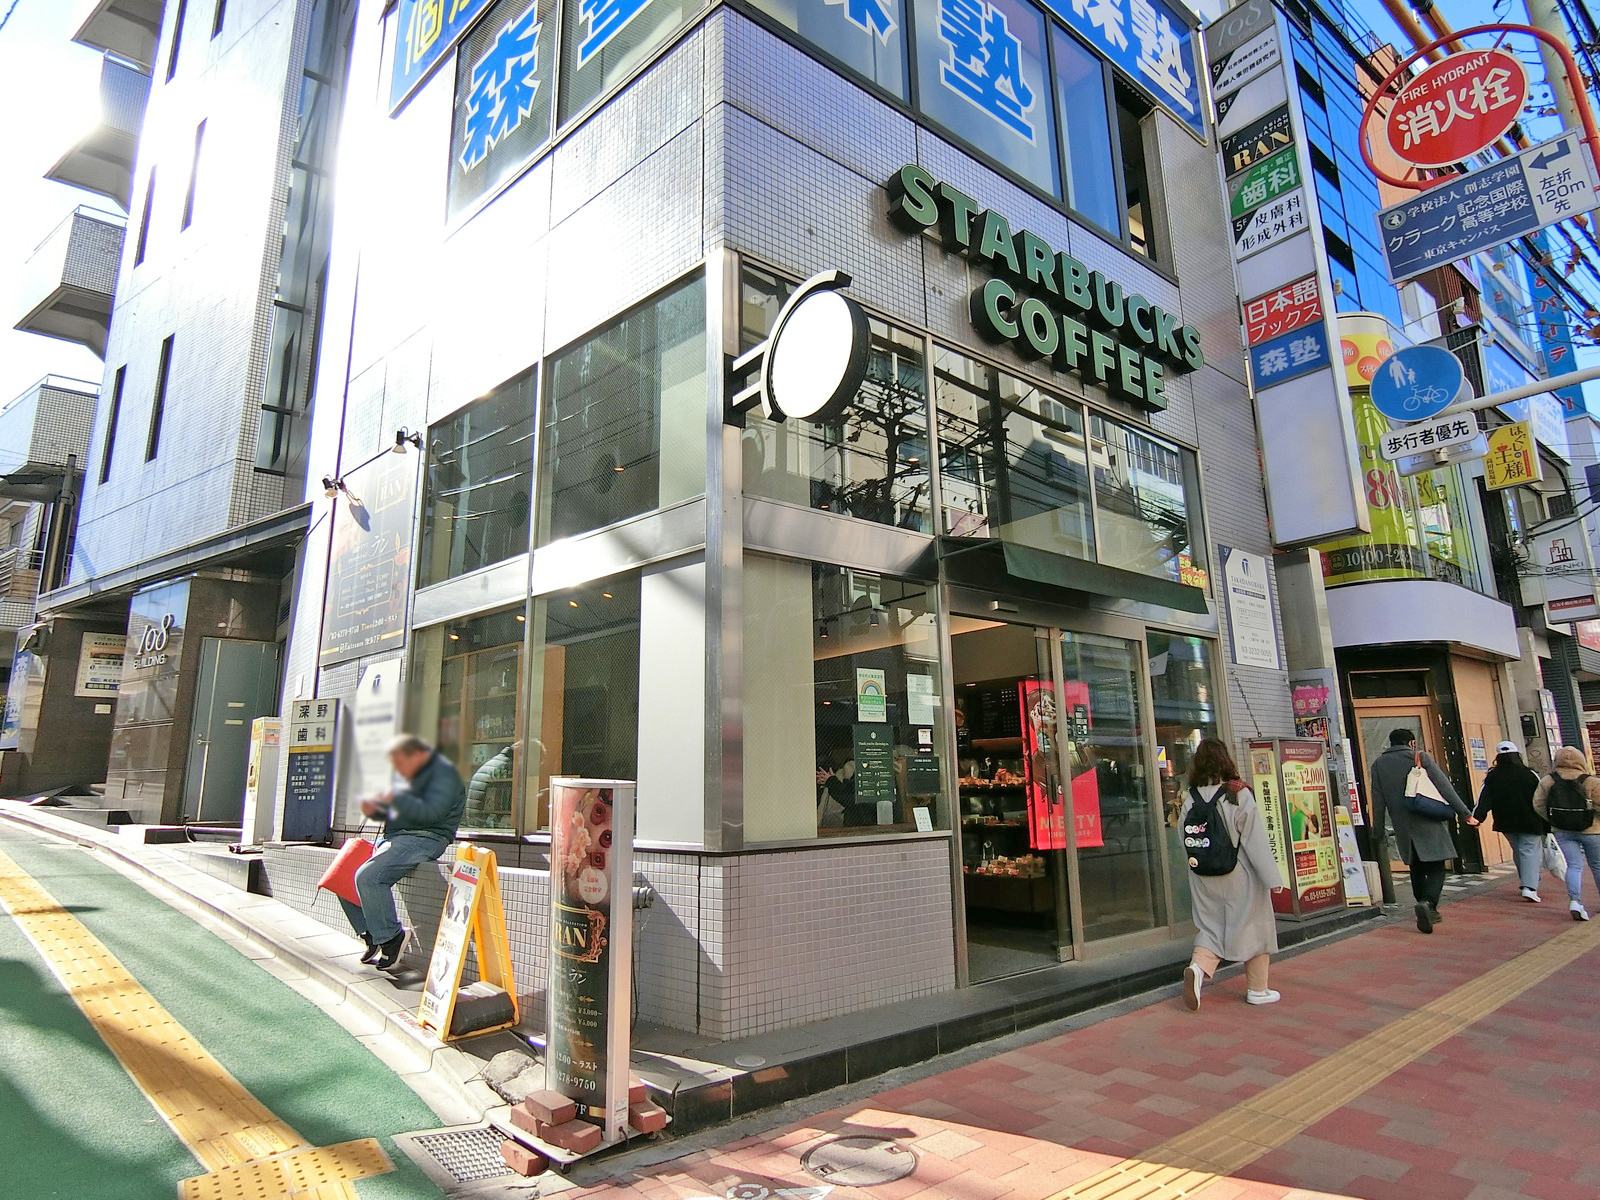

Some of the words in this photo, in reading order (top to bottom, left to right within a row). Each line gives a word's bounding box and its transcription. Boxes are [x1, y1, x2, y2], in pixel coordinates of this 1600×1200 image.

[1213, 60, 1226, 76] 9F
[1401, 83, 1429, 104] FIRE
[1432, 52, 1490, 89] HYDRANT
[459, 1, 543, 174] 森
[1219, 97, 1233, 113] 8F
[1262, 113, 1288, 131] ASIAN
[1396, 67, 1517, 151] 消火栓
[1223, 136, 1237, 151] 7F
[1232, 125, 1290, 172] RAN
[1237, 118, 1289, 150] RELAXATION
[1240, 161, 1297, 209] 歯科
[1406, 191, 1461, 218] 学校法人
[1464, 164, 1520, 196] 創志学園
[1536, 179, 1586, 206] 120m
[1539, 168, 1572, 191] 左折
[1254, 195, 1301, 229] 皮膚科
[1457, 179, 1526, 217] 記念国際
[1459, 194, 1530, 232] 高等学校
[1554, 199, 1571, 214] 先
[1235, 218, 1248, 232] 5F
[1241, 211, 1303, 252] 形成外科
[1388, 213, 1456, 253] クラーク
[1423, 224, 1500, 260] 東京キャンパス
[889, 163, 1205, 373] STARBUCKS
[1247, 276, 1318, 324] 日本語
[1249, 302, 1321, 342] ブックス
[970, 278, 1167, 414] COFFEE
[1259, 335, 1322, 377] 森塾
[1387, 420, 1470, 454] 歩行者優先
[370, 535, 389, 558] ラン
[136, 612, 174, 656] 108
[133, 654, 169, 669] BUILDING
[299, 703, 328, 719] 深野
[297, 727, 327, 742] 歯科
[1040, 814, 1096, 830] METY
[555, 921, 588, 948] RAN
[568, 968, 587, 985] ラン
